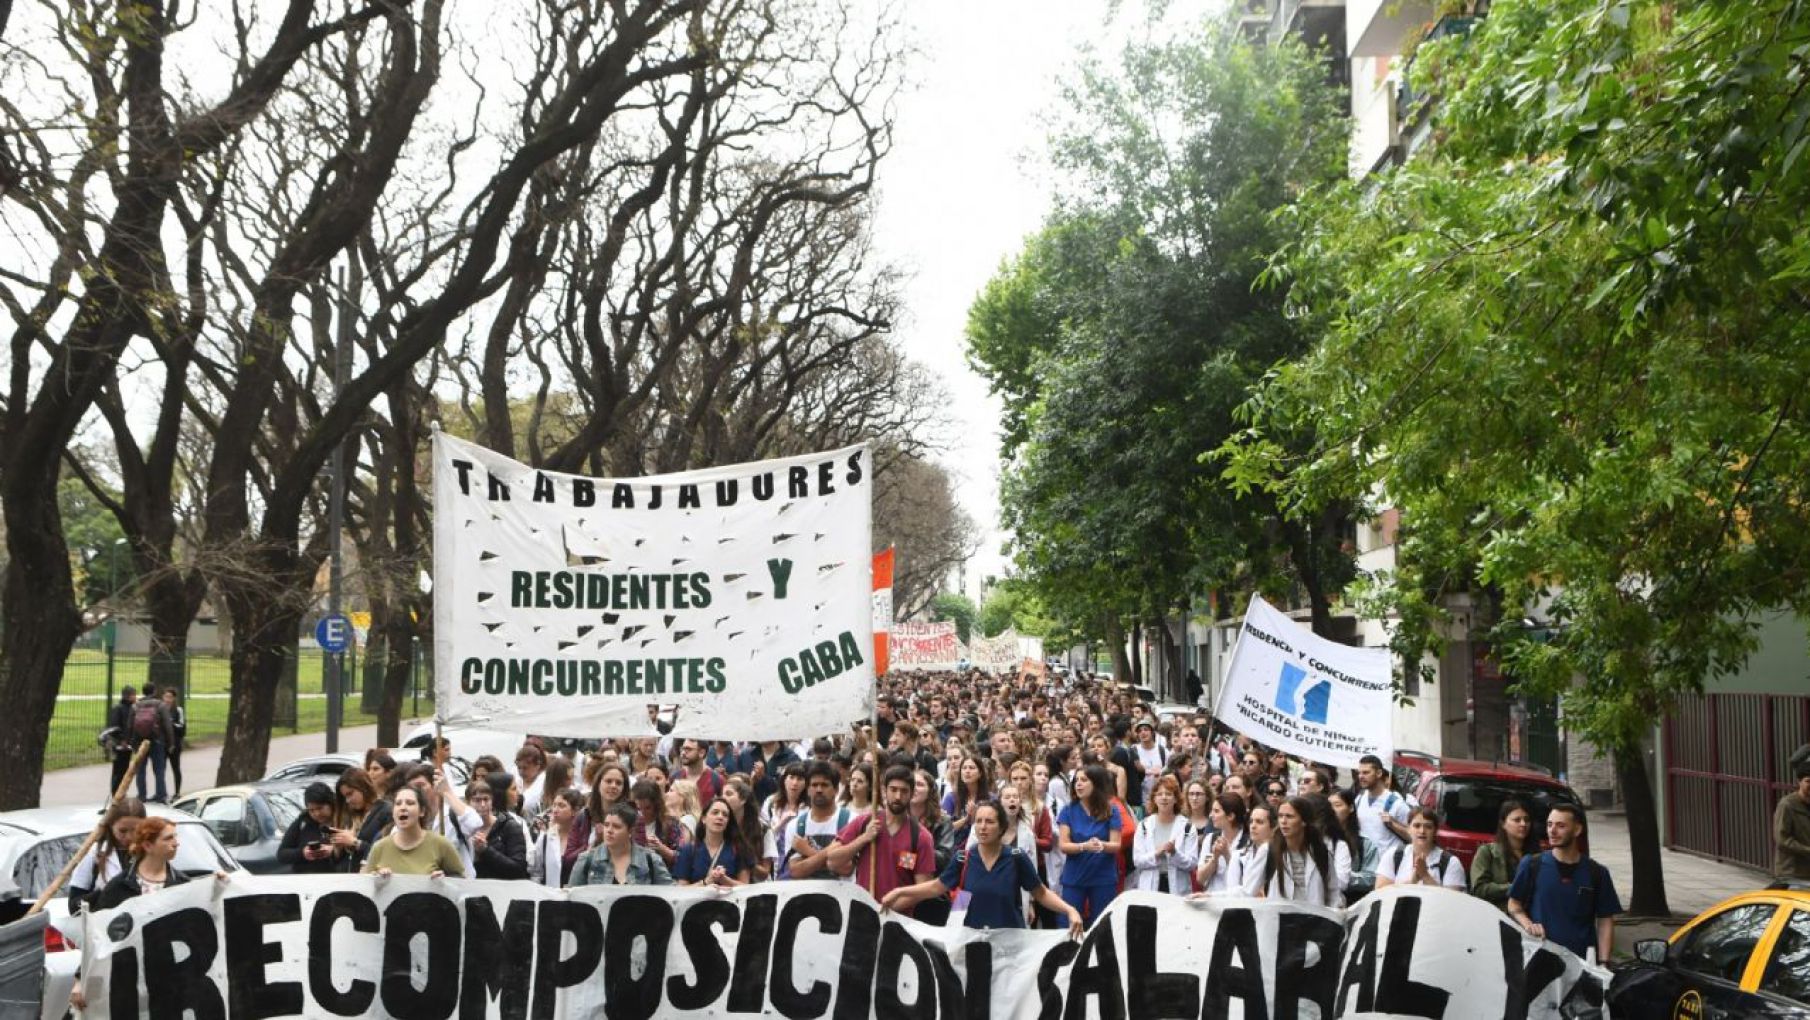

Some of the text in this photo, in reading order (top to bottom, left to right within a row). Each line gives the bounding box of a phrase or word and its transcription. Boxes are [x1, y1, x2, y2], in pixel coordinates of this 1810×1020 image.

[452, 450, 863, 510] TRABAJADORES
[511, 558, 793, 610] RESIDENTES Y
[327, 619, 345, 641] E
[461, 631, 863, 696] CONCURRENTES CABA
[1299, 651, 1307, 660] Y
[1244, 693, 1299, 729] HOSPITAL
[1303, 725, 1319, 735] DE
